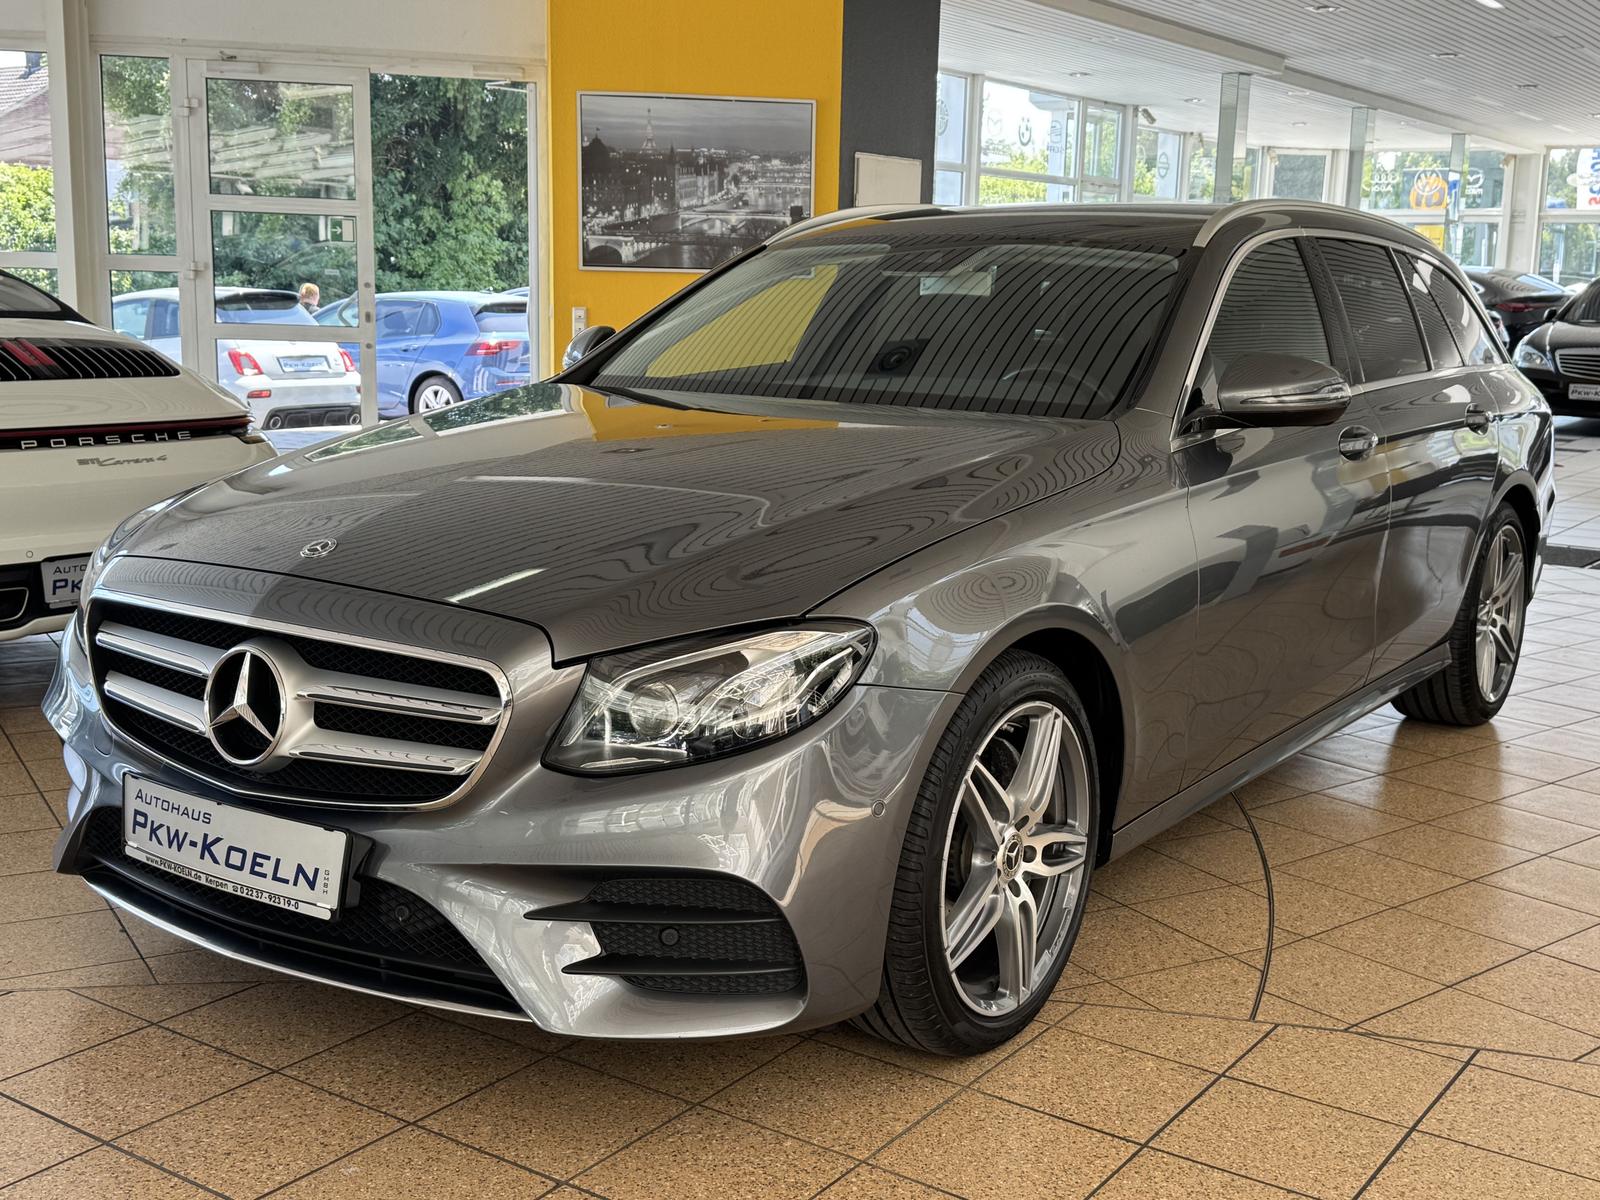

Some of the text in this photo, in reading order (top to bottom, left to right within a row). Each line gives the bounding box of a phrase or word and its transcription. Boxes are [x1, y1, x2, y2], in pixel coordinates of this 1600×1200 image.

[20, 431, 192, 450] PORSCHE
[134, 788, 212, 825] AUTOHAUS
[132, 808, 320, 891] PKW-KOELN
[205, 873, 229, 891] Kerpen
